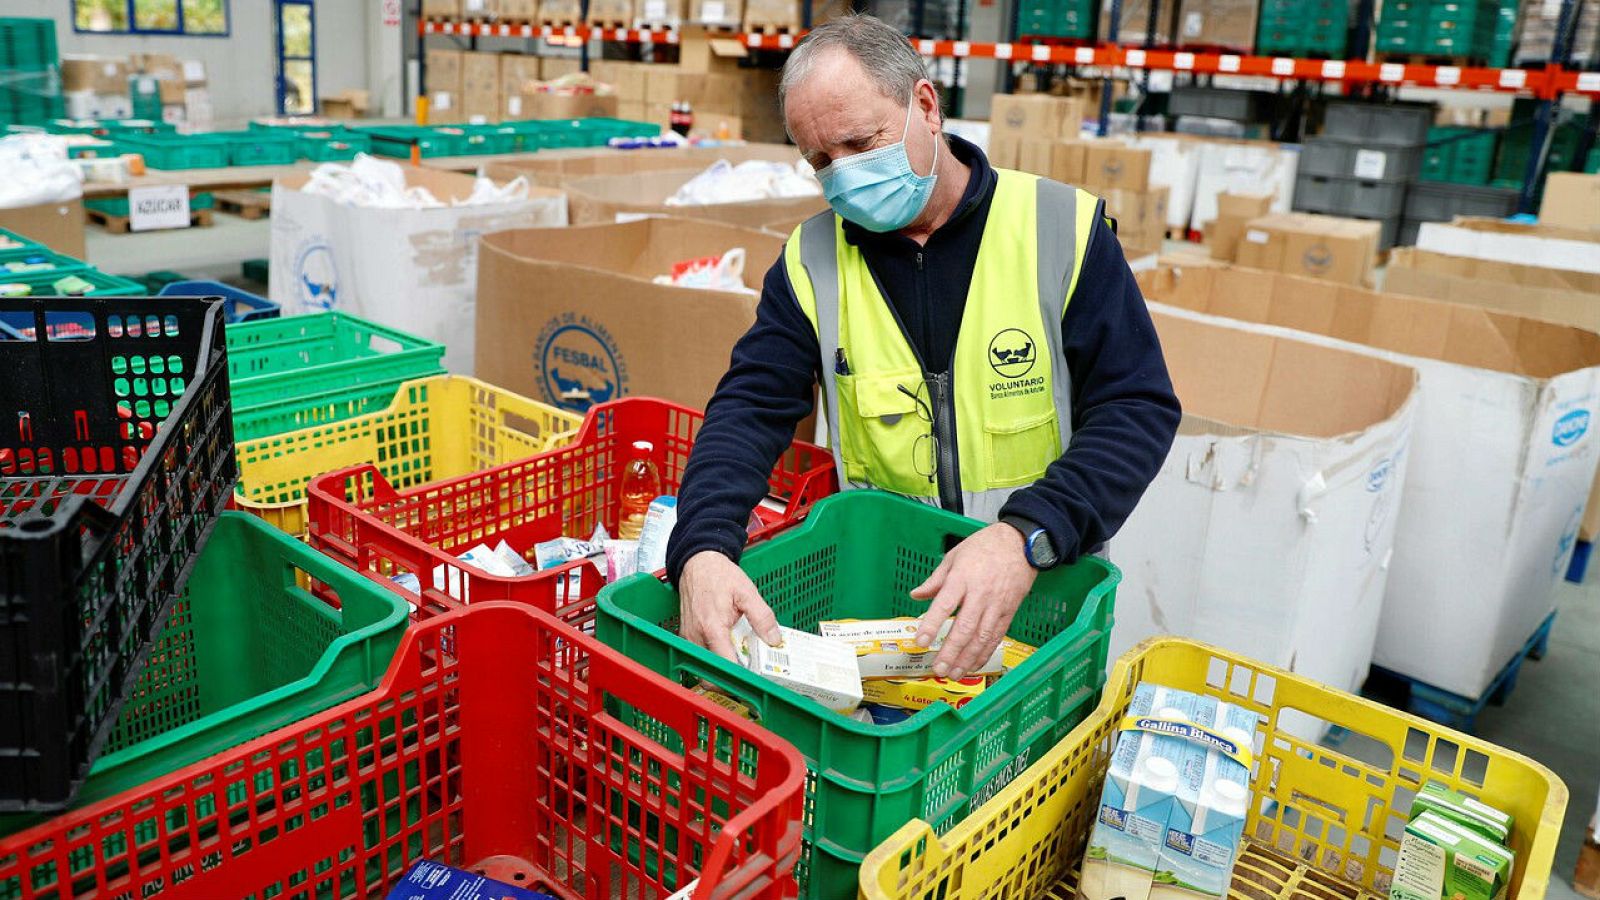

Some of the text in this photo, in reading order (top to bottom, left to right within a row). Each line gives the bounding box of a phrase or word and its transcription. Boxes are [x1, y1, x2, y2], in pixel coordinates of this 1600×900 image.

[553, 346, 608, 373] FESBAL
[989, 376, 1044, 391] VOLUNTARIO
[875, 628, 902, 637] girasol
[884, 663, 894, 671] En
[1140, 719, 1233, 753] Gallina Blanca
